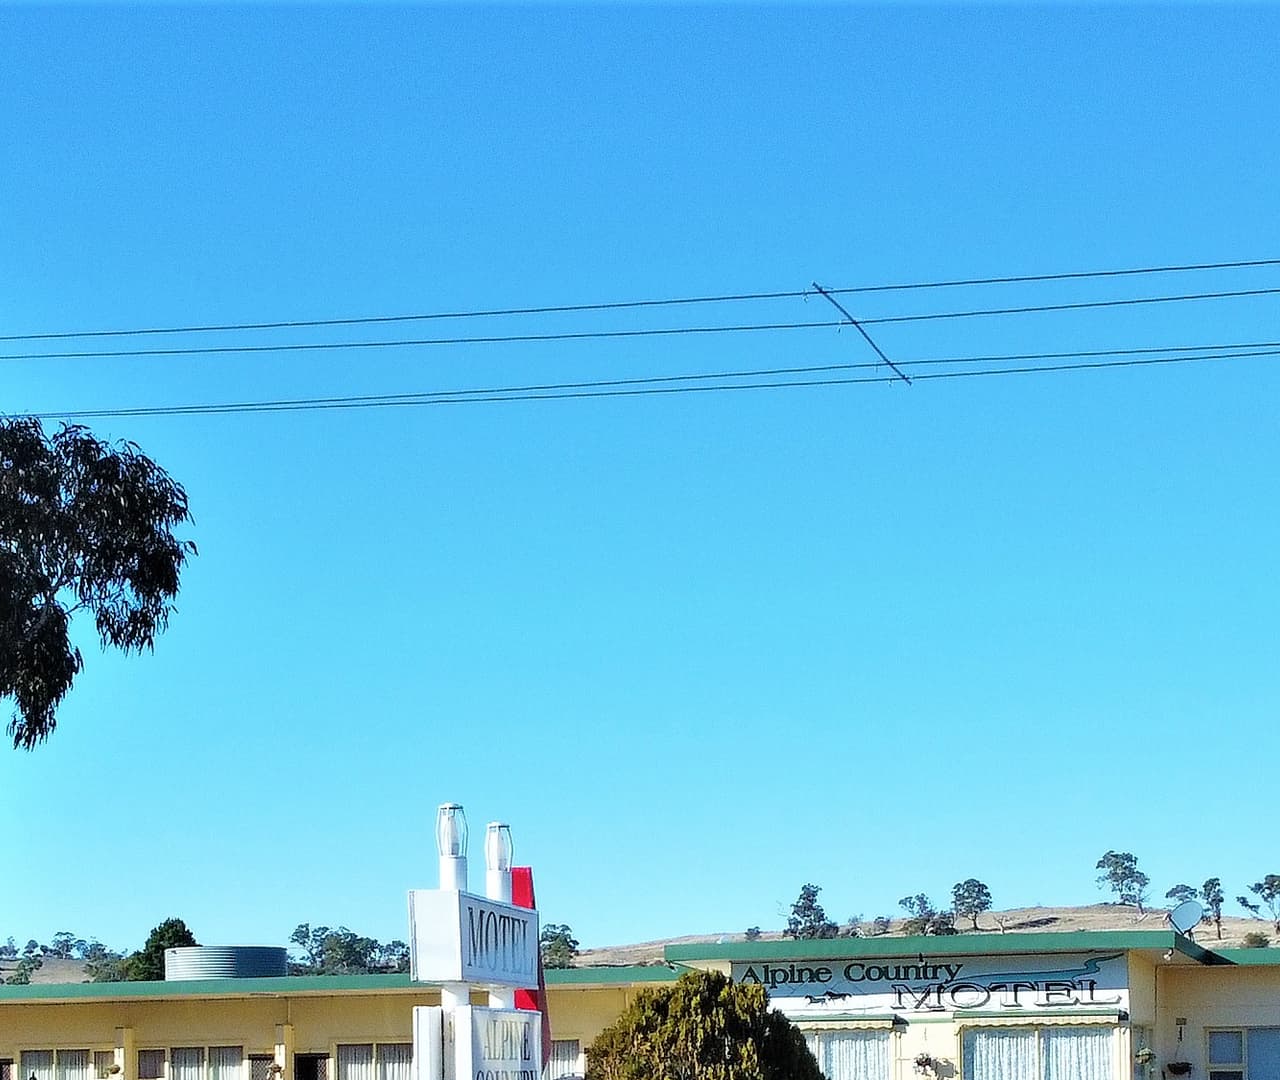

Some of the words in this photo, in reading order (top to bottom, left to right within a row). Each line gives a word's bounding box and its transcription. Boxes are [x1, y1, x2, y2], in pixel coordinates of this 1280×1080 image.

[467, 906, 535, 978] MOTEL
[741, 964, 833, 989] Alpine
[844, 962, 963, 984] Country
[890, 979, 1123, 1012] MOTEL
[483, 1019, 531, 1061] ALPINE
